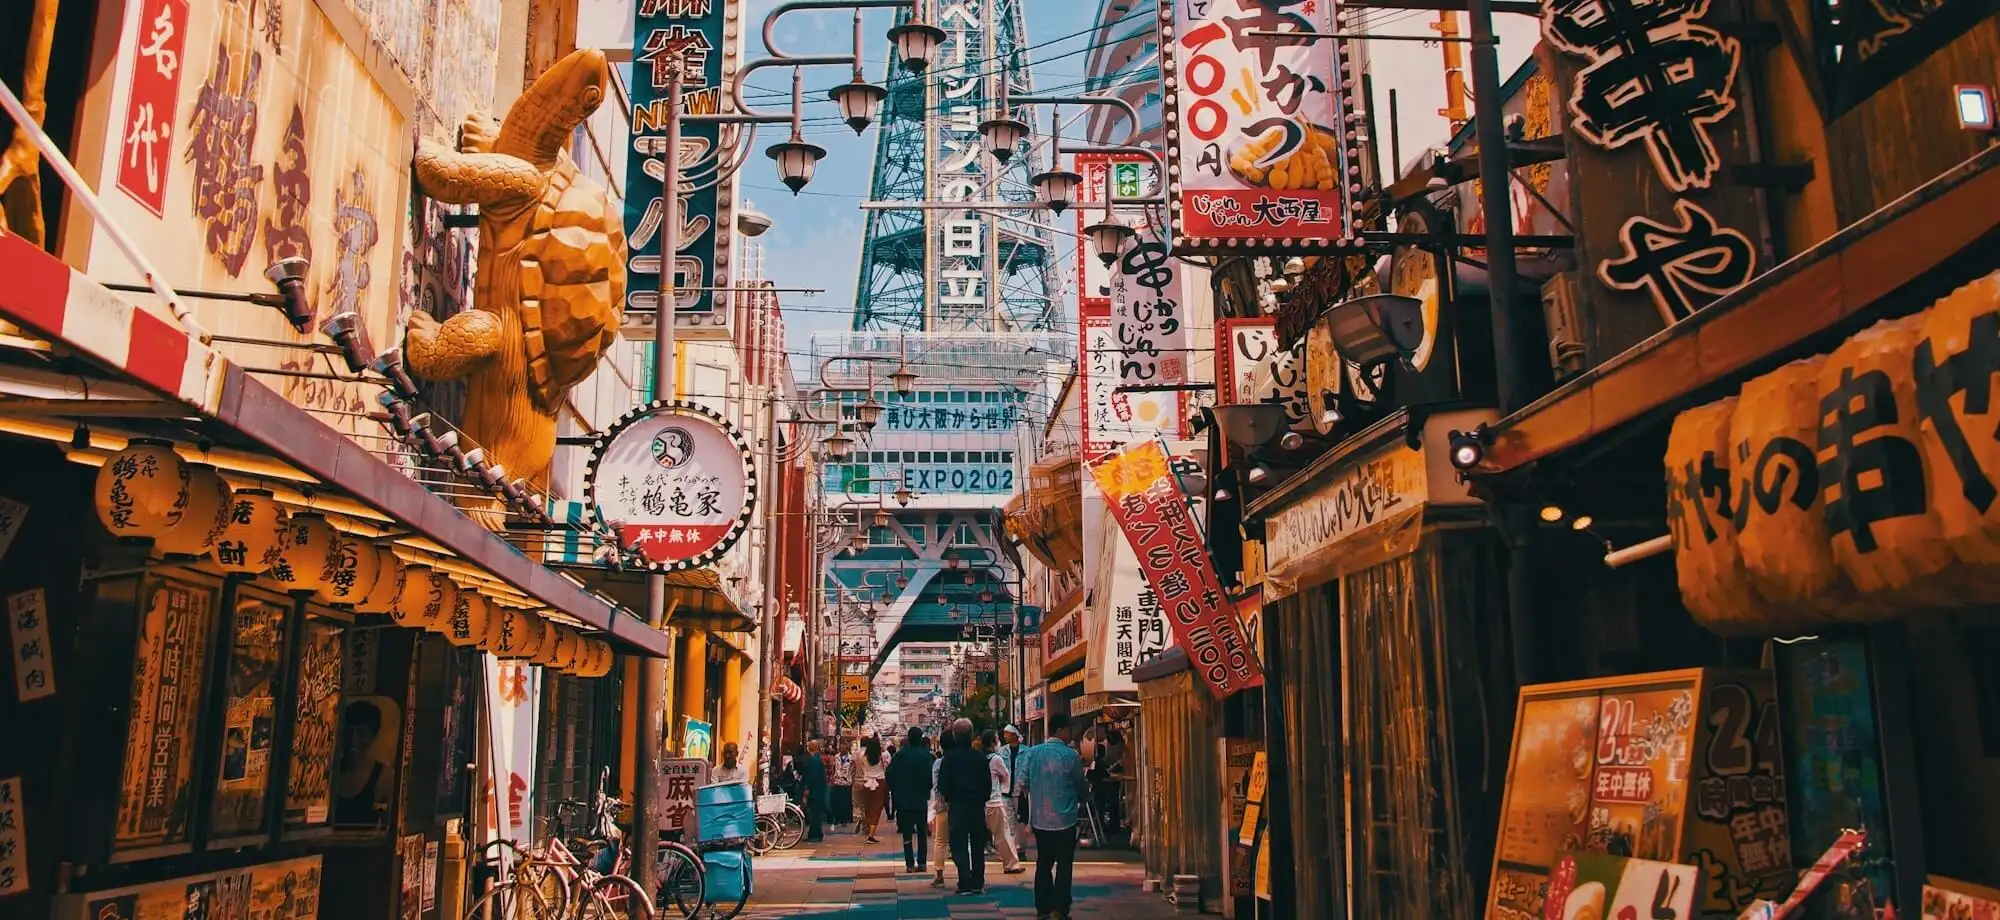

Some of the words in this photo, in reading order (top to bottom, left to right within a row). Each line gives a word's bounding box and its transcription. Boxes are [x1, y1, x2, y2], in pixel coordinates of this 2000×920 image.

[127, 12, 178, 194] 名代
[627, 136, 711, 309] マルコ
[1095, 381, 1110, 436] たこ焼き
[110, 452, 139, 529] 鶴亀家
[642, 485, 723, 517] 鶴亀家
[636, 527, 702, 544] 年中無休
[1116, 606, 1134, 676] 通天閣店
[1595, 770, 1652, 799] 年中無休
